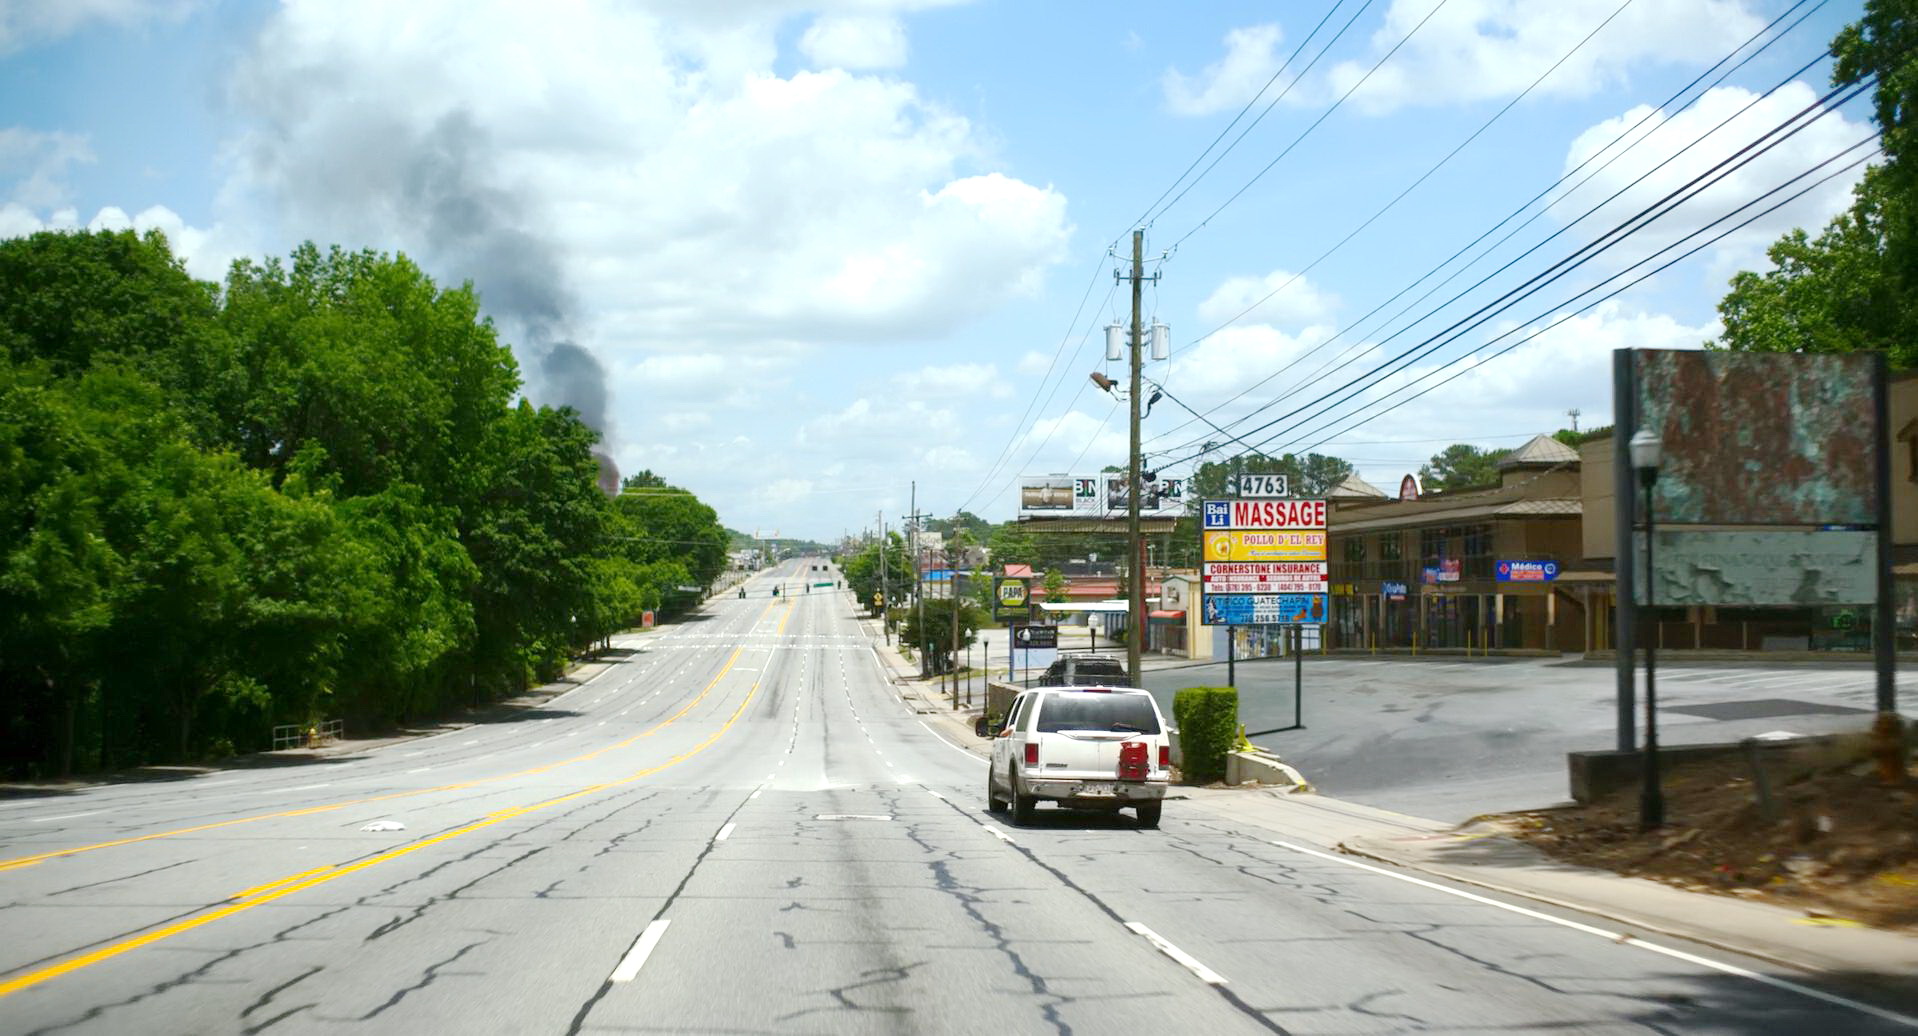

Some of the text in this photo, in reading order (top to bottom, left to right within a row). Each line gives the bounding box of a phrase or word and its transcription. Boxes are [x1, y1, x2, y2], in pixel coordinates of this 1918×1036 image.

[1243, 477, 1285, 494] 4763
[1207, 503, 1228, 514] Bai
[1235, 502, 1324, 526] MASSAGE
[1211, 514, 1224, 525] Li
[1244, 535, 1274, 545] POLLO
[1305, 535, 1324, 545] REY
[1210, 563, 1321, 574] CORNERSTONE INSURANCE
[1511, 563, 1543, 571] Médico
